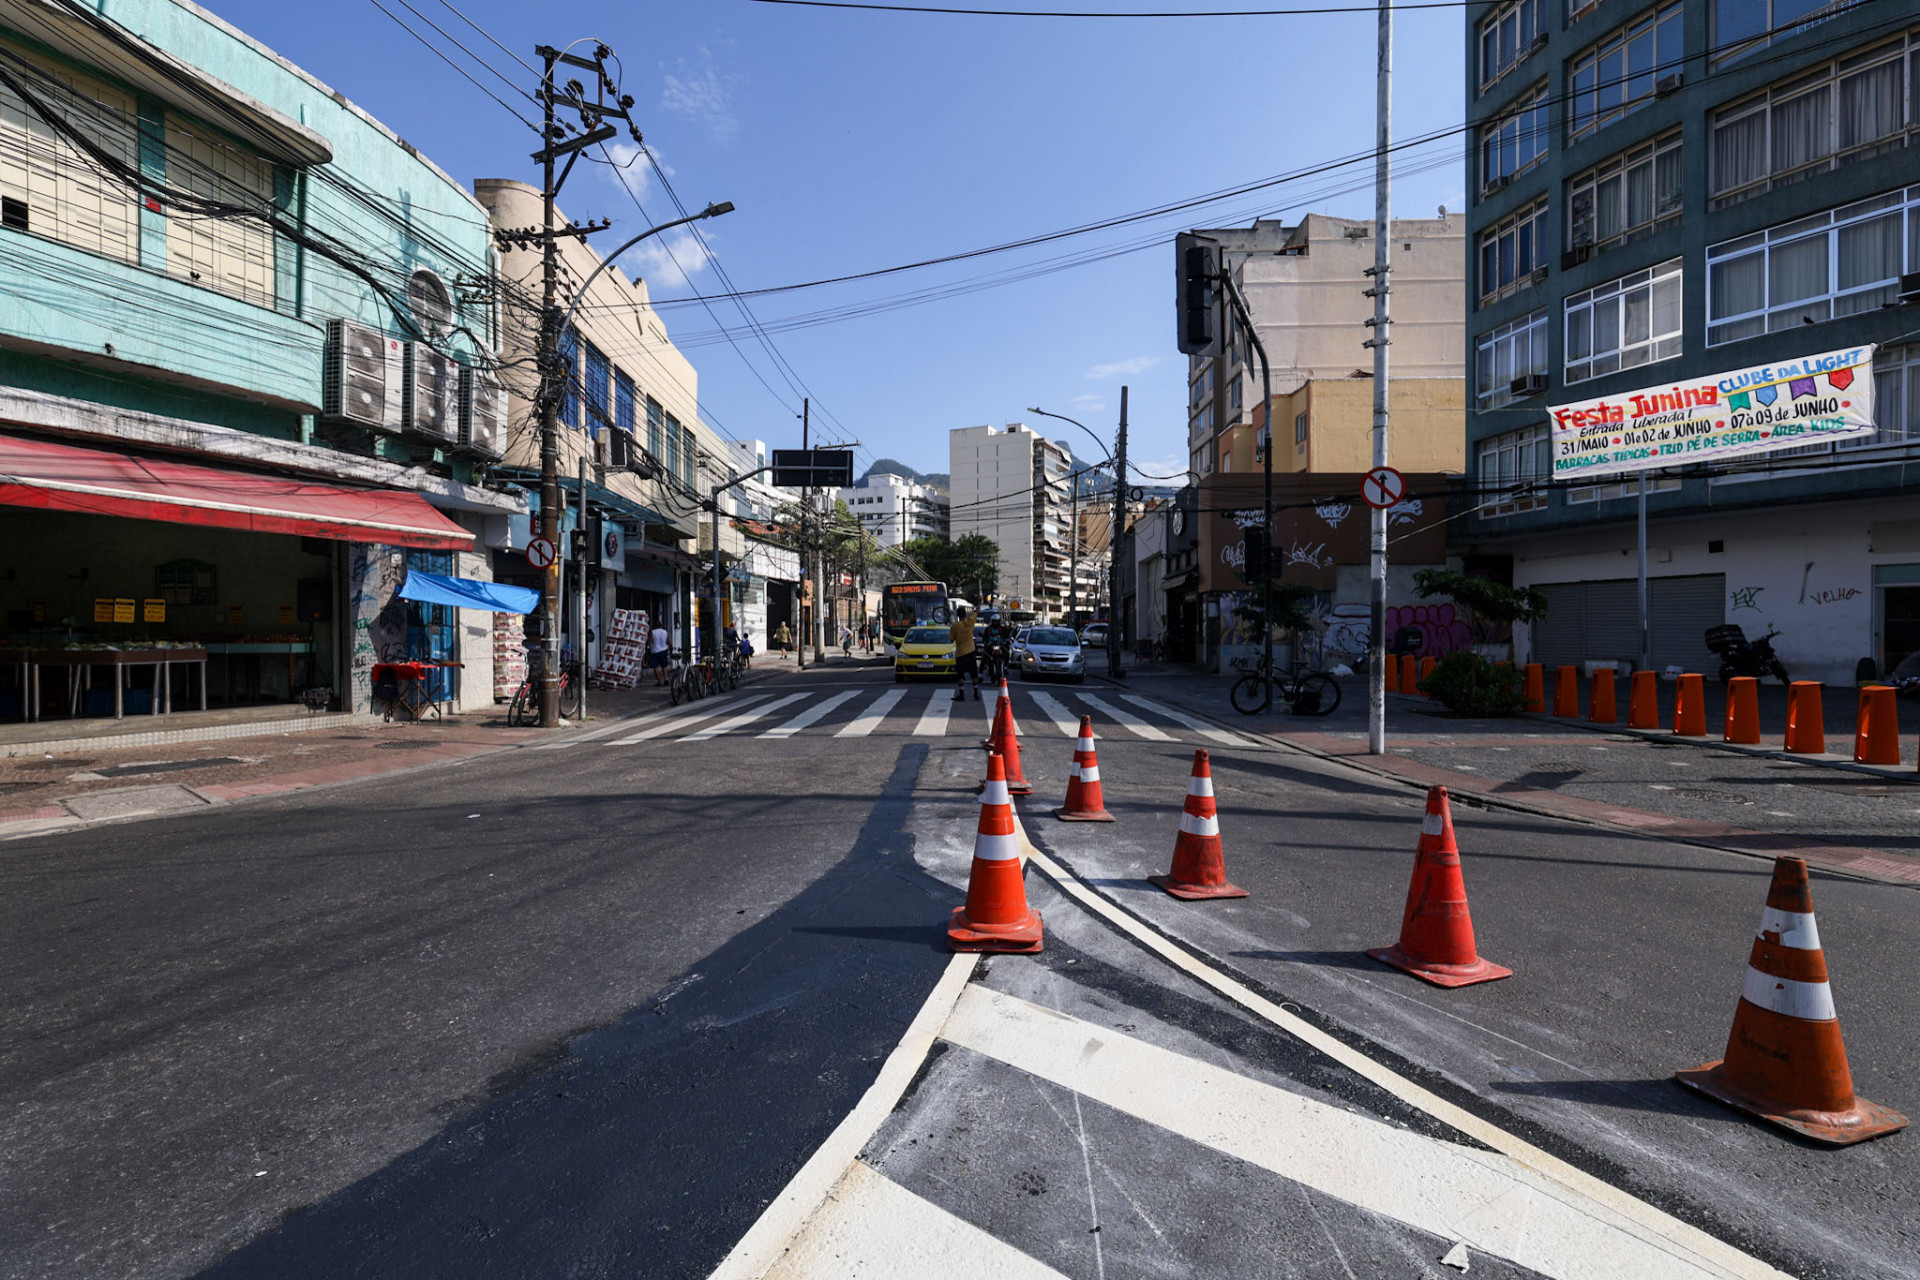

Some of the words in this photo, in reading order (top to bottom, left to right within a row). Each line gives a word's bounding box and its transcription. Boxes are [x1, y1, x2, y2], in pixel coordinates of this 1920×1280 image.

[1718, 368, 1775, 393] CLUBE
[1778, 364, 1802, 379] DA
[1802, 349, 1864, 375] LIGHT
[1554, 402, 1624, 430] Festa
[1629, 386, 1718, 419] Junina
[1561, 437, 1609, 455] 31/MAIO
[1658, 427, 1670, 440] de
[1672, 419, 1711, 440] JUNHO
[1776, 406, 1790, 420] de
[1792, 397, 1839, 419] JUNHO
[1580, 422, 1624, 437] Entrada
[1555, 454, 1610, 470] BARRACAS
[1613, 447, 1651, 462] TÍPICAS
[1657, 442, 1683, 456] TRIO
[1687, 435, 1702, 452] PÉ
[1704, 437, 1719, 449] DE
[1722, 430, 1761, 445] SERRA
[1771, 423, 1805, 438] ÁREA
[1810, 416, 1846, 431] KIDS
